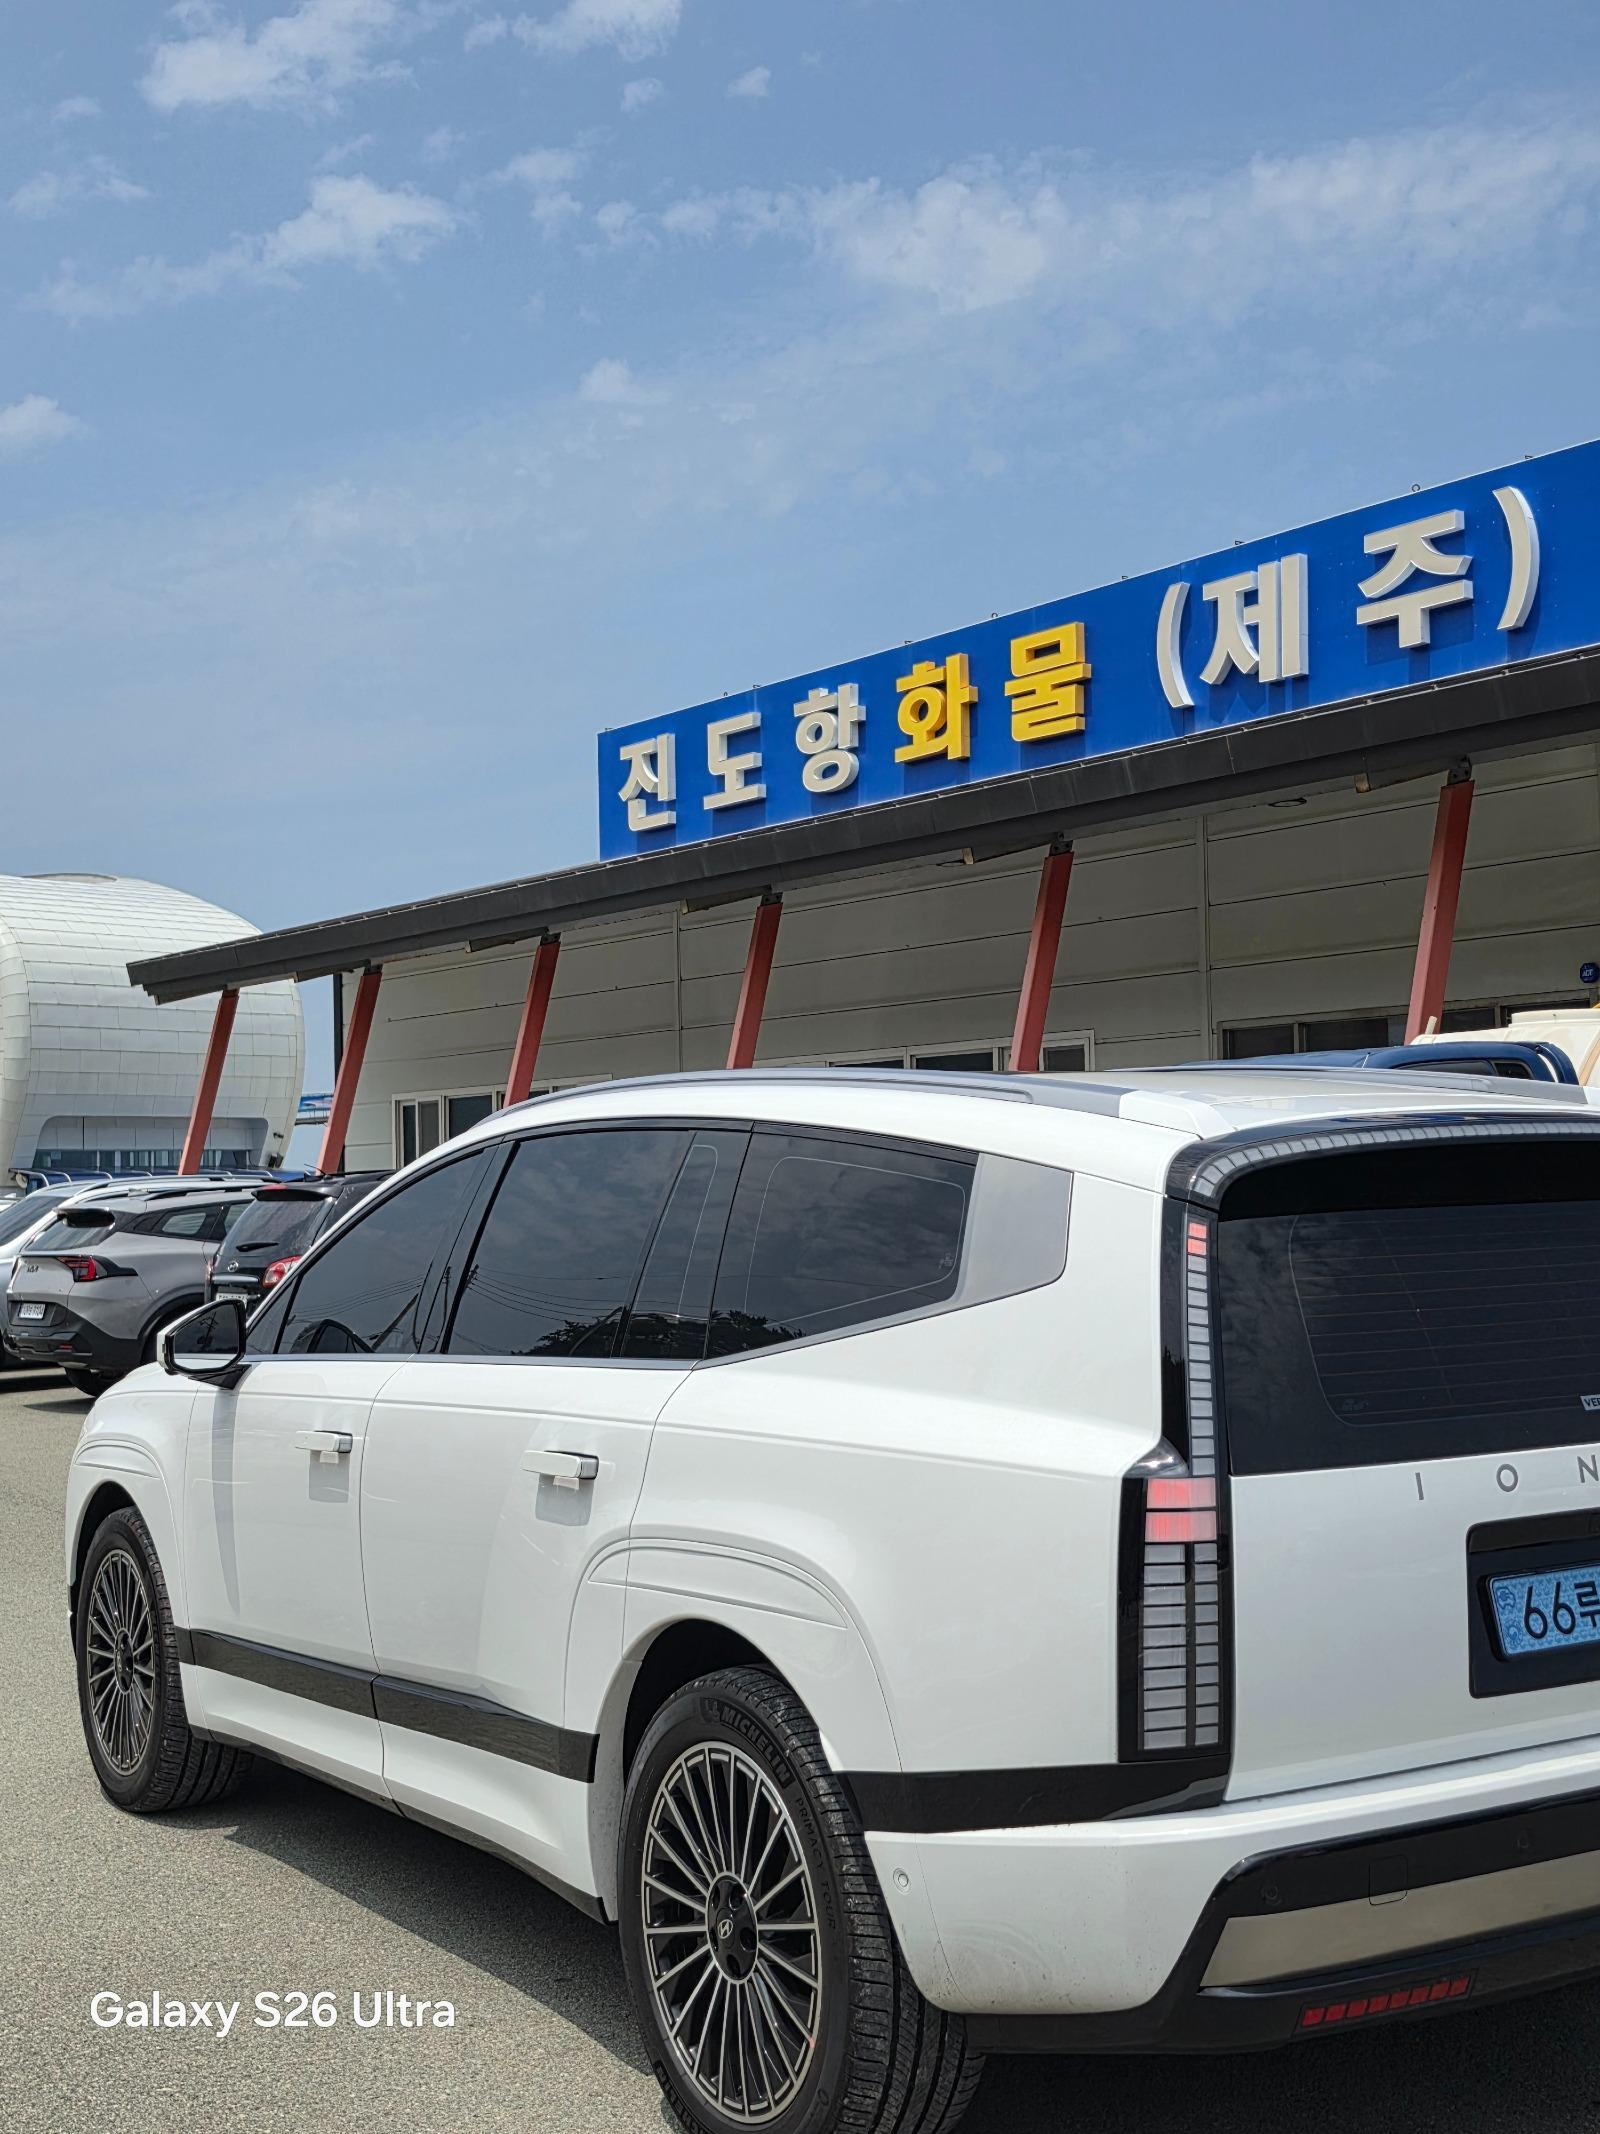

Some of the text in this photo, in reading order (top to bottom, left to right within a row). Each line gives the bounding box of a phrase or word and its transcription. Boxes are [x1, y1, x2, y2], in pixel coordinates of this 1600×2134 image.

[1524, 1581, 1600, 1639] 66루
[721, 1705, 792, 1784] MICHELIN
[796, 1797, 836, 1930] PRIMACY TOUR
